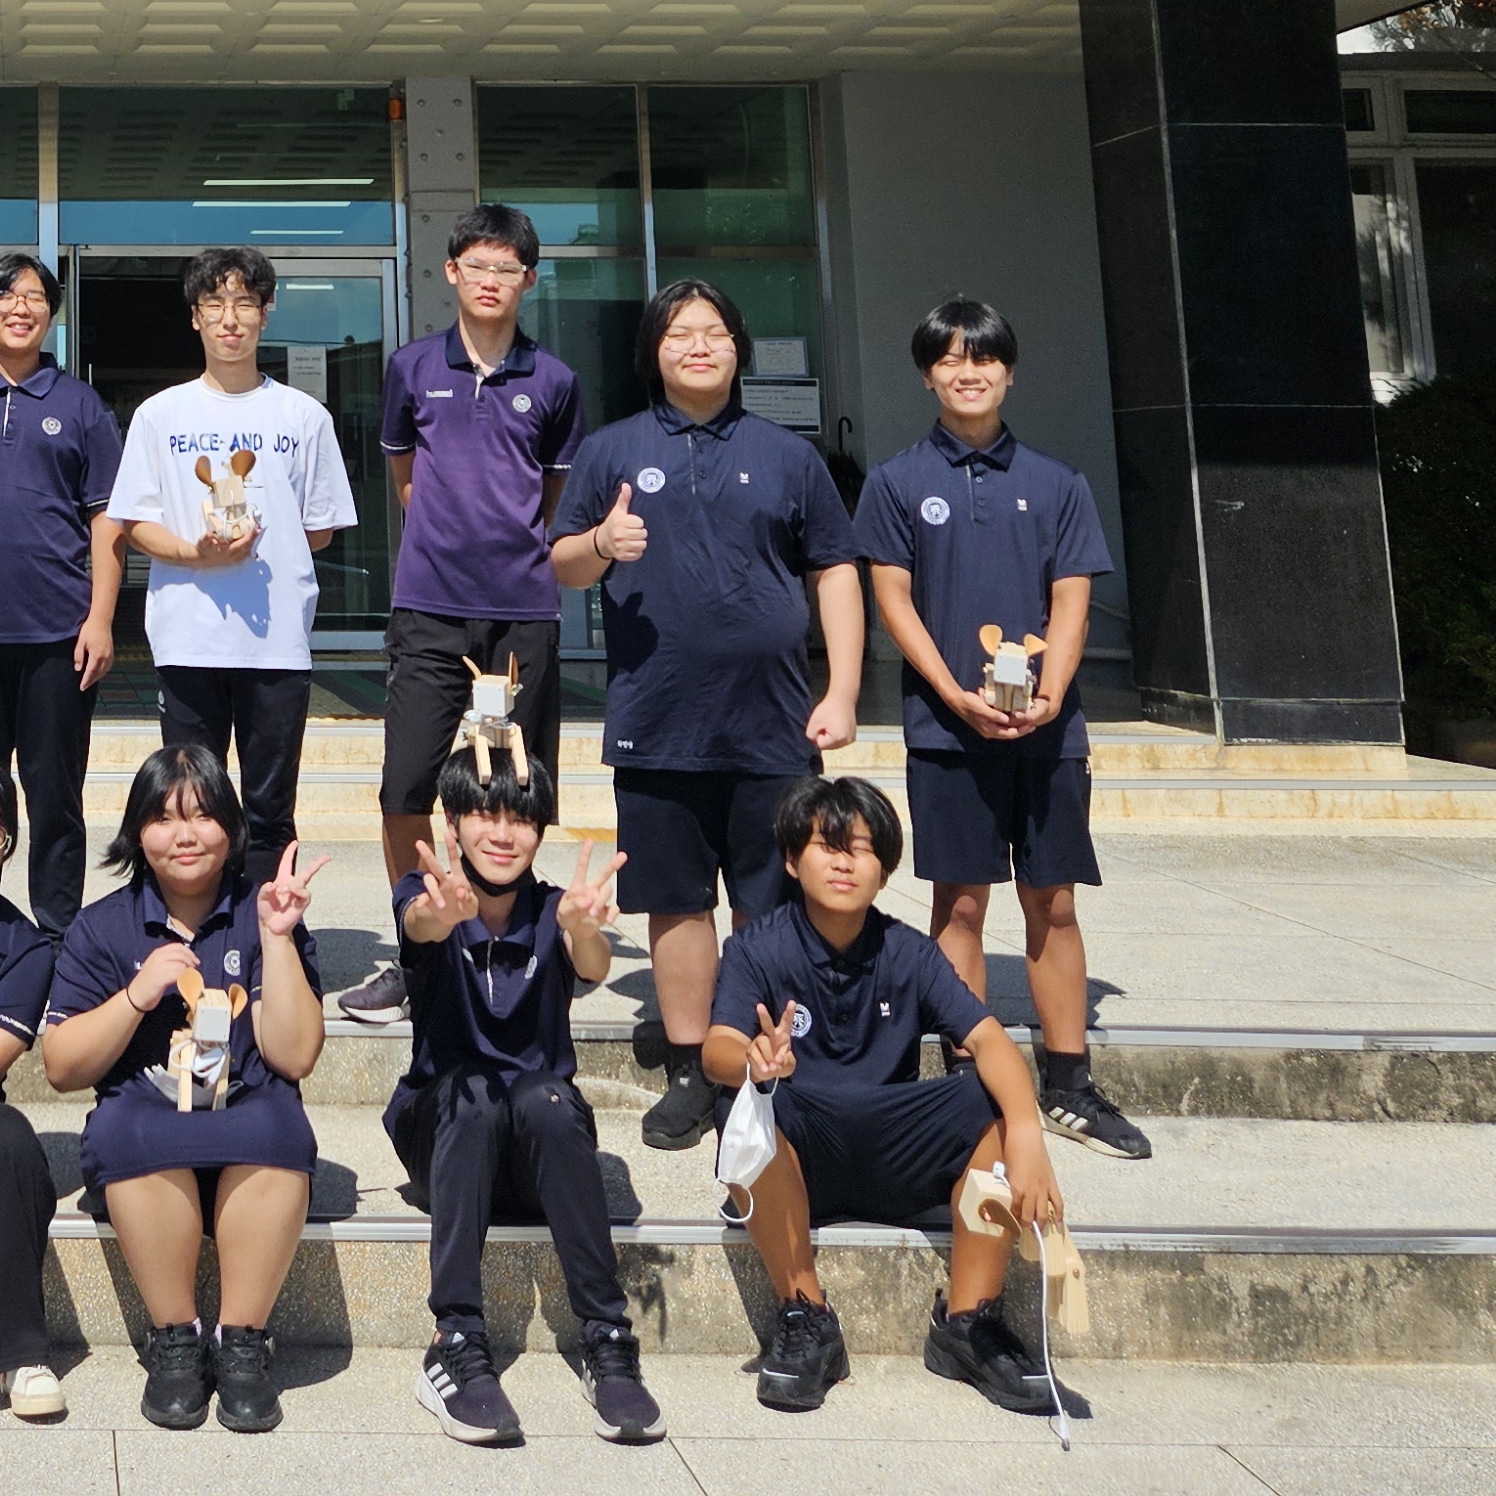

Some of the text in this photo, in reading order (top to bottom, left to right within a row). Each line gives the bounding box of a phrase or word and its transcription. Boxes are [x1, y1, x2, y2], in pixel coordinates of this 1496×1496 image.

[169, 432, 299, 458] PEACE AND JOY
